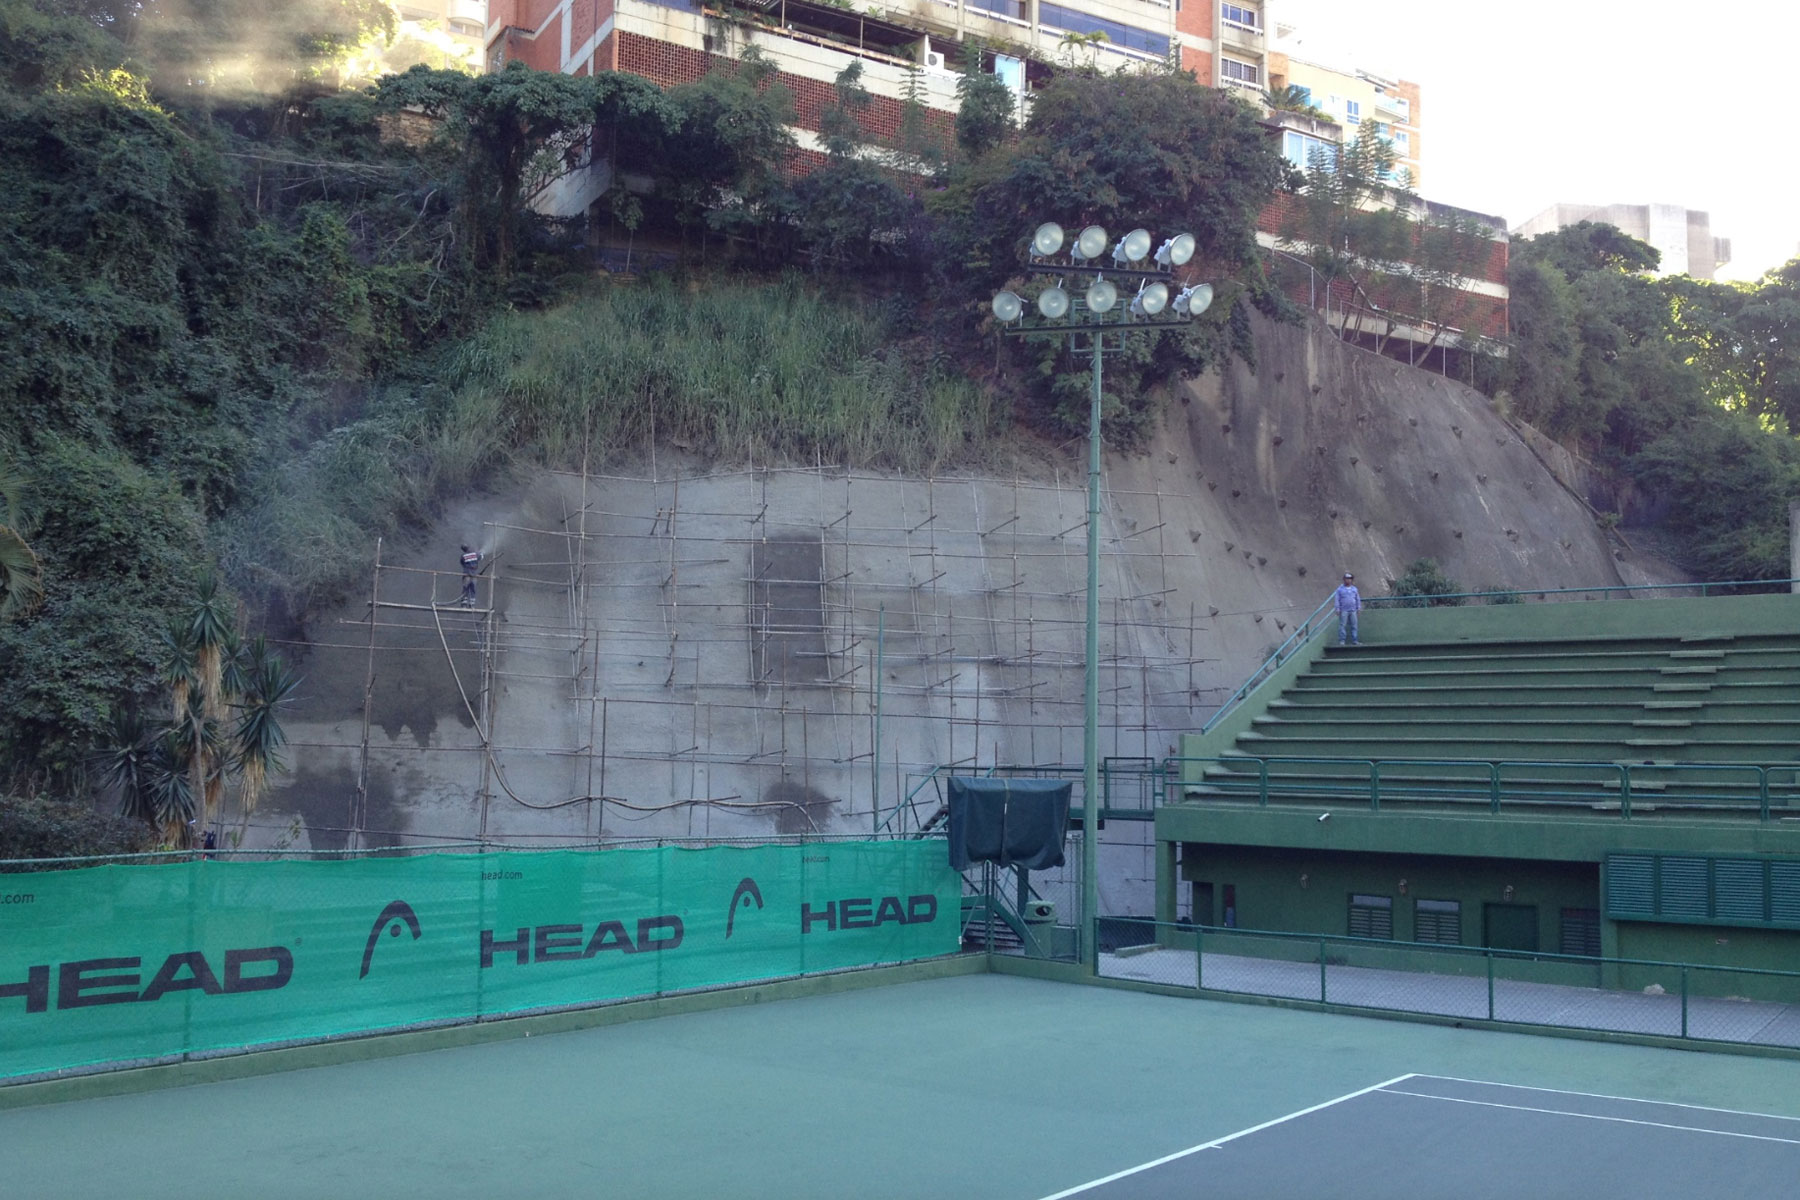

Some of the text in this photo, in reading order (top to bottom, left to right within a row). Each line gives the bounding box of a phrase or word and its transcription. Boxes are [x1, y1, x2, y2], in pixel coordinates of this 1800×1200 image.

[481, 869, 523, 880] head.com
[801, 894, 937, 934] HEAD
[480, 915, 684, 969] HEAD
